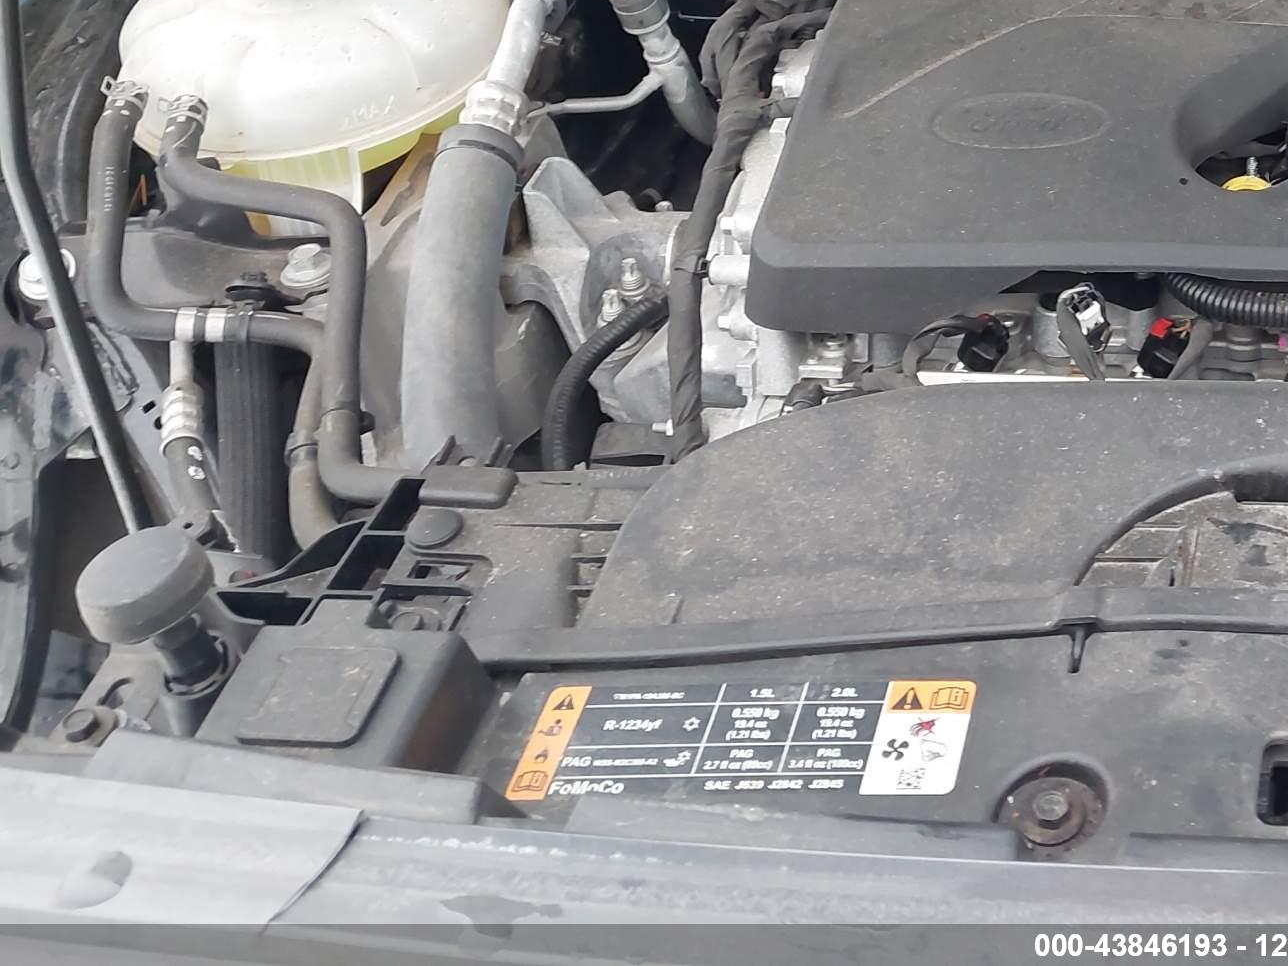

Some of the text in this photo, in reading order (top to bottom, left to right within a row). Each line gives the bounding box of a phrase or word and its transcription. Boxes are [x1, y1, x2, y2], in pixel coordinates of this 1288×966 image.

[602, 718, 664, 732] R-1234yf
[729, 749, 755, 759] PAG
[816, 747, 842, 758] PAG
[560, 756, 592, 767] PAG
[548, 780, 625, 795] FoMoCo
[703, 780, 732, 791] SAE
